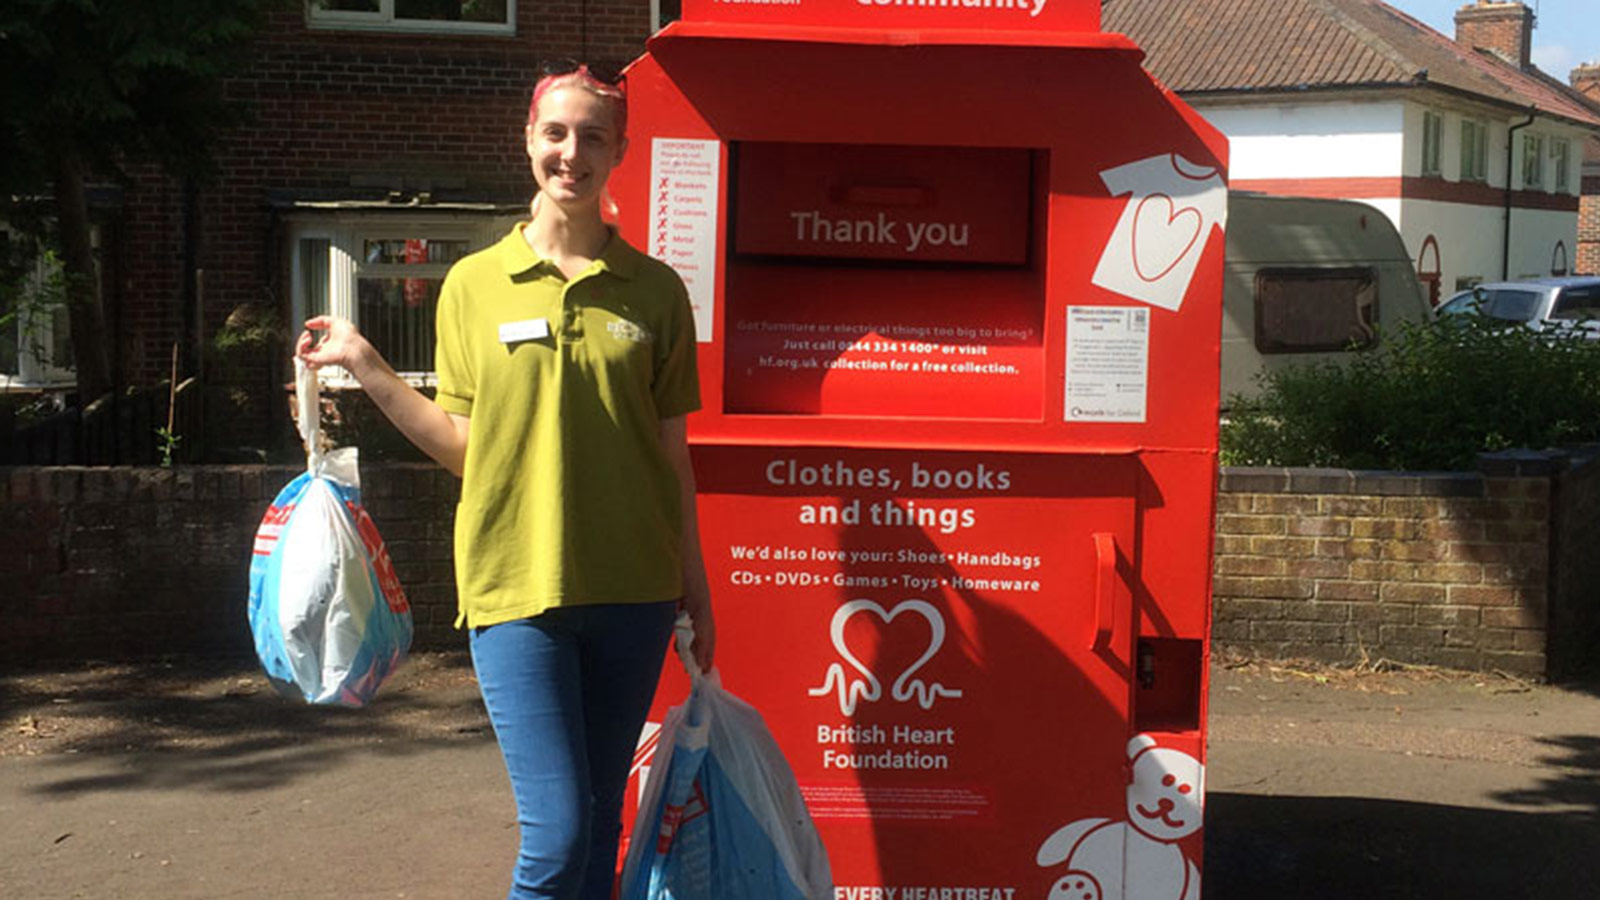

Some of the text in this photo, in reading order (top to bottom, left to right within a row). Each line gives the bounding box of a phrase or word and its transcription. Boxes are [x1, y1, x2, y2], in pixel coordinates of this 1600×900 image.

[674, 181, 707, 189] Blankets
[791, 211, 969, 252] Thank you
[760, 321, 817, 333] furniture
[818, 324, 829, 333] or
[833, 322, 890, 335] electrical
[893, 324, 931, 338] things
[934, 326, 954, 337] too
[957, 327, 977, 340] big
[979, 328, 992, 338] to
[783, 340, 810, 351] Just
[811, 340, 836, 351] call
[873, 342, 898, 353] 334
[941, 345, 956, 355] or
[958, 344, 988, 355] visit
[823, 357, 888, 370] collection
[890, 359, 910, 371] for
[912, 362, 921, 371] a
[922, 361, 948, 372] free
[950, 361, 1020, 374] collection.
[766, 459, 1011, 491] Clothes, books
[799, 500, 976, 533] and things
[774, 546, 808, 561] also
[811, 547, 846, 562] love
[850, 550, 894, 566] your:
[898, 549, 946, 564] Shoes
[957, 552, 1041, 569] Handbags
[731, 571, 1041, 592] CDs DVDs Games Toys Homeware
[817, 724, 955, 745] British Heart
[823, 749, 948, 769] Foundation
[833, 886, 1016, 900] EVERY HEARTBEAT
